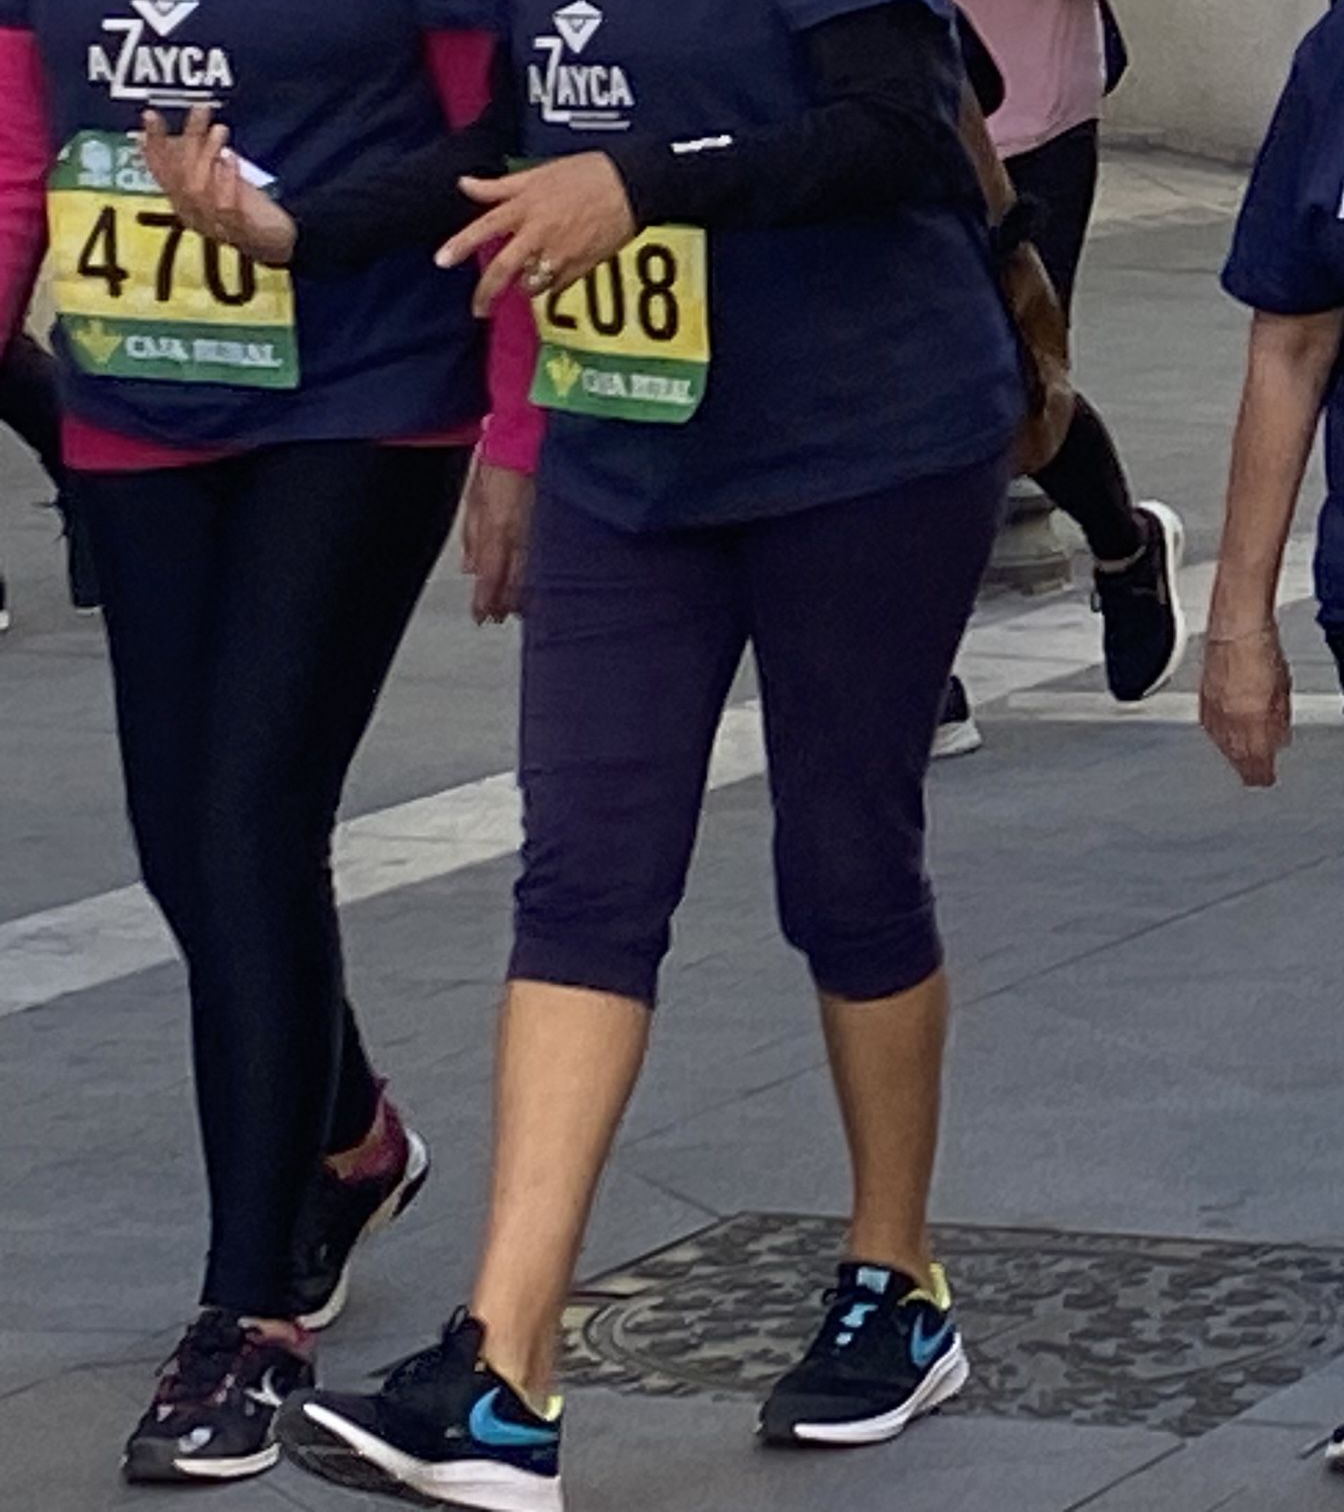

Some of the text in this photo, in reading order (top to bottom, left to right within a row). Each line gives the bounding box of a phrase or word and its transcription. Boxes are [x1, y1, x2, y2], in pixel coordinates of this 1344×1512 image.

[88, 19, 234, 99] AZAYCA
[527, 36, 635, 122] AZAYCA
[77, 205, 257, 306] 470
